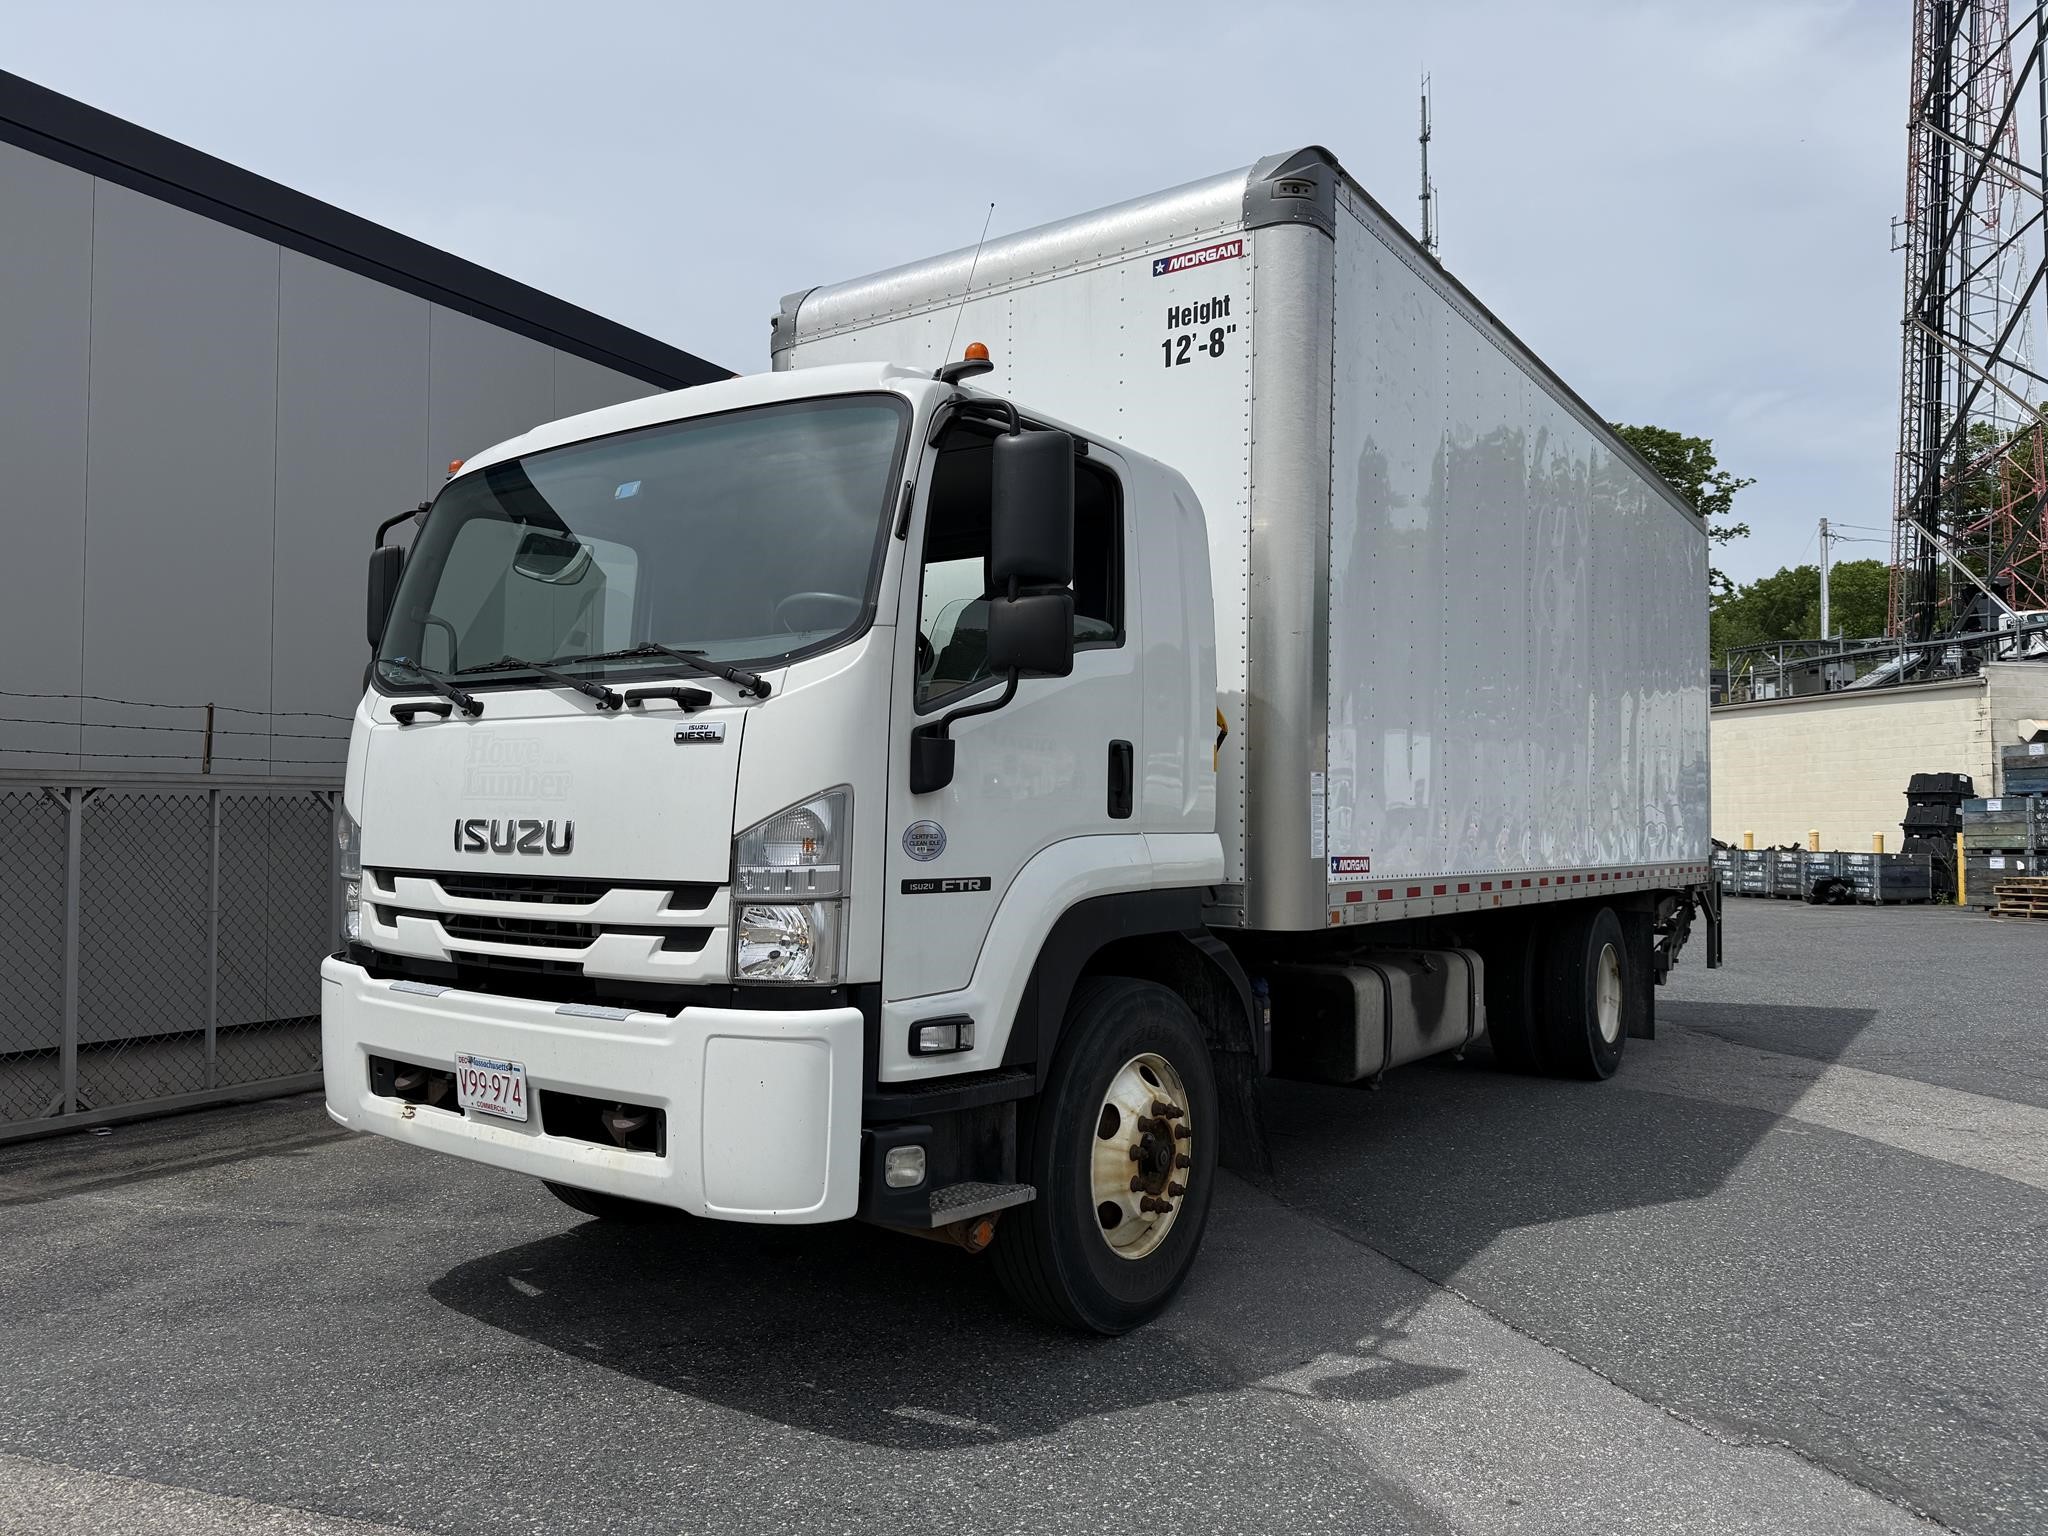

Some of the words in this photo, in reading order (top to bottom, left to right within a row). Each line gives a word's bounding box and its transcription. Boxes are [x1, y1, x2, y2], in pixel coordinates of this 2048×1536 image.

[1168, 242, 1239, 271] MORGAN
[1167, 294, 1231, 330] Height
[1161, 323, 1237, 368] 12'-8"
[675, 731, 721, 741] DIESEL
[454, 818, 576, 856] ISUZU
[1338, 859, 1369, 871] MORGAN
[909, 882, 935, 891] ISUZU
[941, 879, 981, 892] FTR
[476, 1100, 508, 1114] COMMERCIAL
